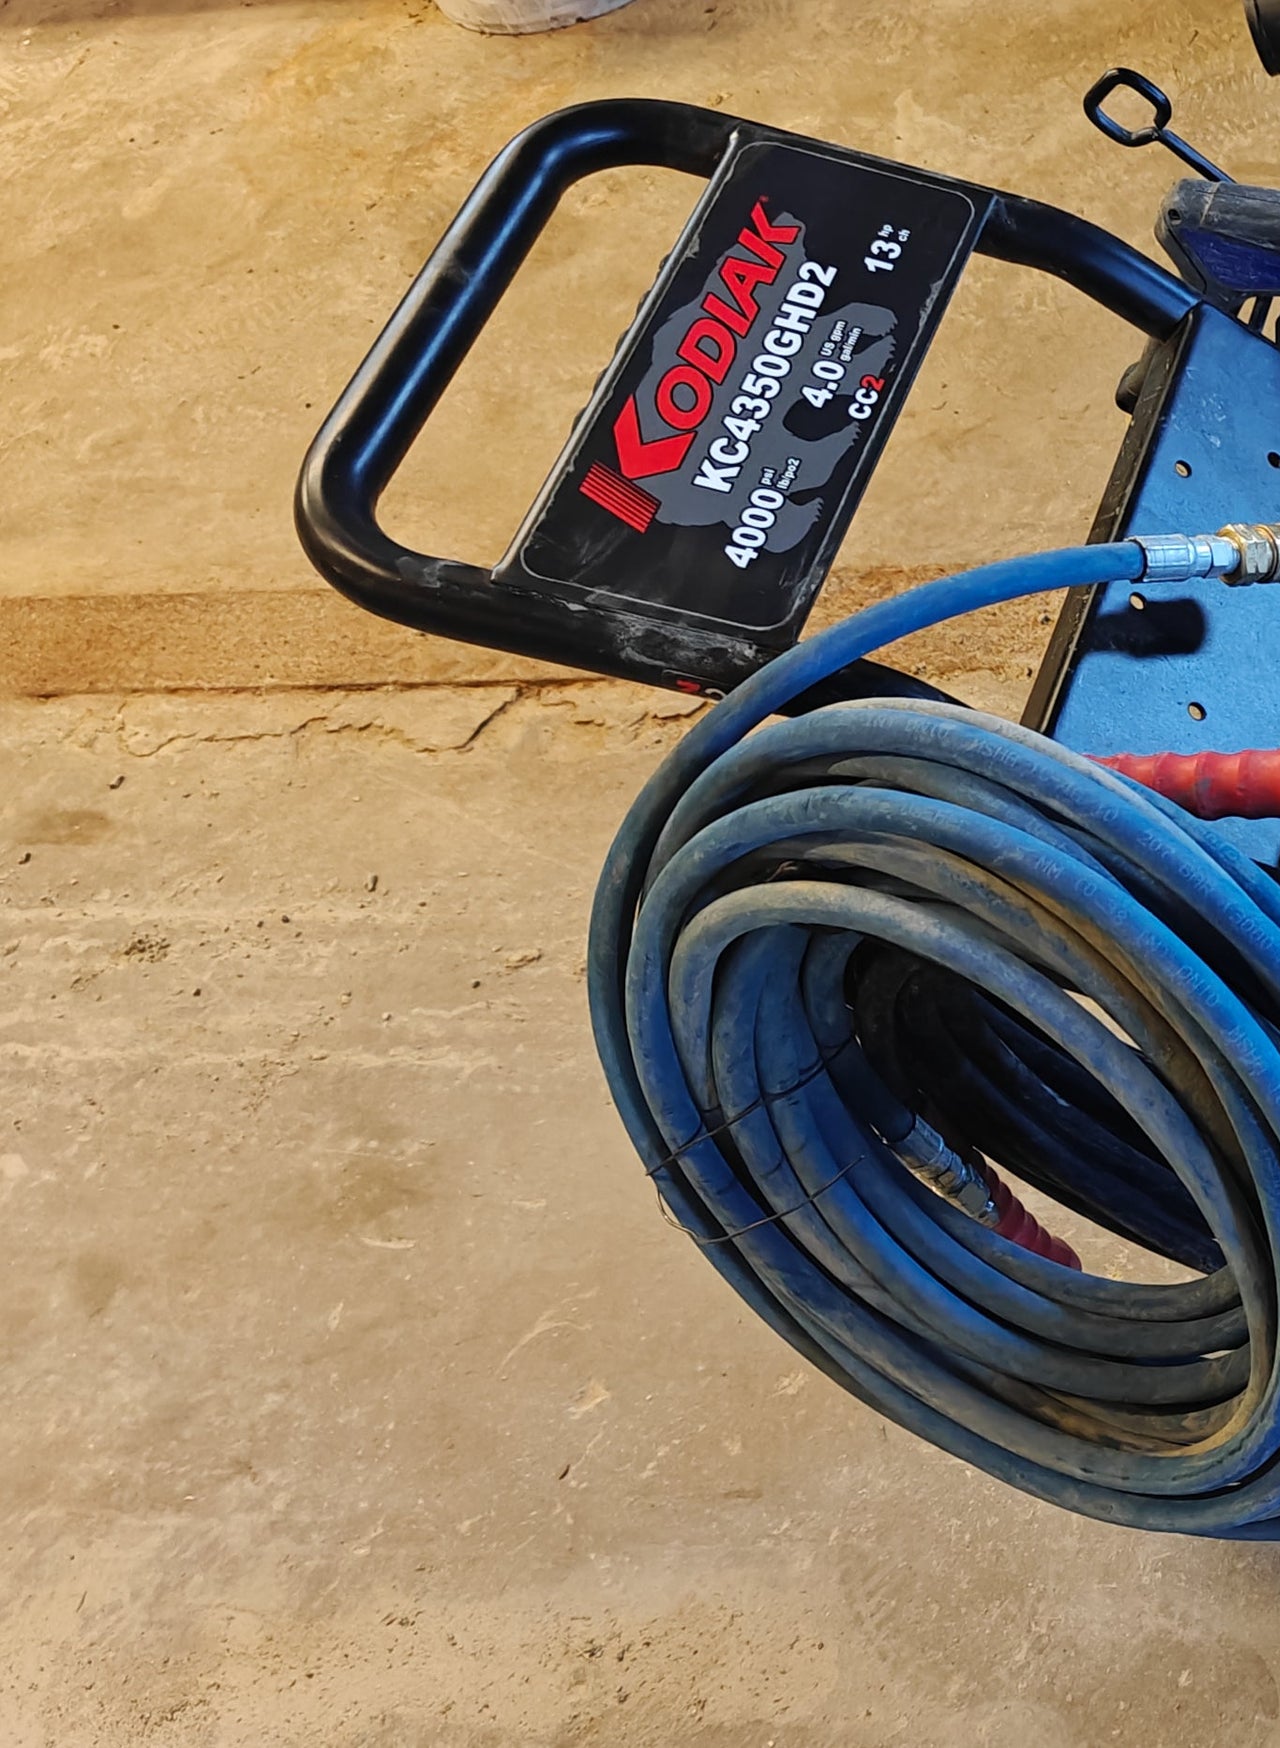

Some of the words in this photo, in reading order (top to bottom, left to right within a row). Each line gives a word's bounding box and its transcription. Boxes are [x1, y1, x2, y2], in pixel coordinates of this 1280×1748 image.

[878, 224, 894, 238] hp
[898, 229, 911, 242] ch
[863, 239, 901, 272] 13
[830, 320, 847, 343] gpm
[840, 327, 862, 362] gal/min
[820, 342, 836, 357] US
[579, 201, 800, 534] KODIAK
[693, 261, 837, 493] KC4350GHD2
[802, 360, 845, 408] 4.0
[848, 375, 885, 420] CC2
[776, 457, 801, 490] lb/po2
[725, 488, 785, 569] 4000
[761, 468, 775, 486] psi
[1032, 852, 1065, 883] MM
